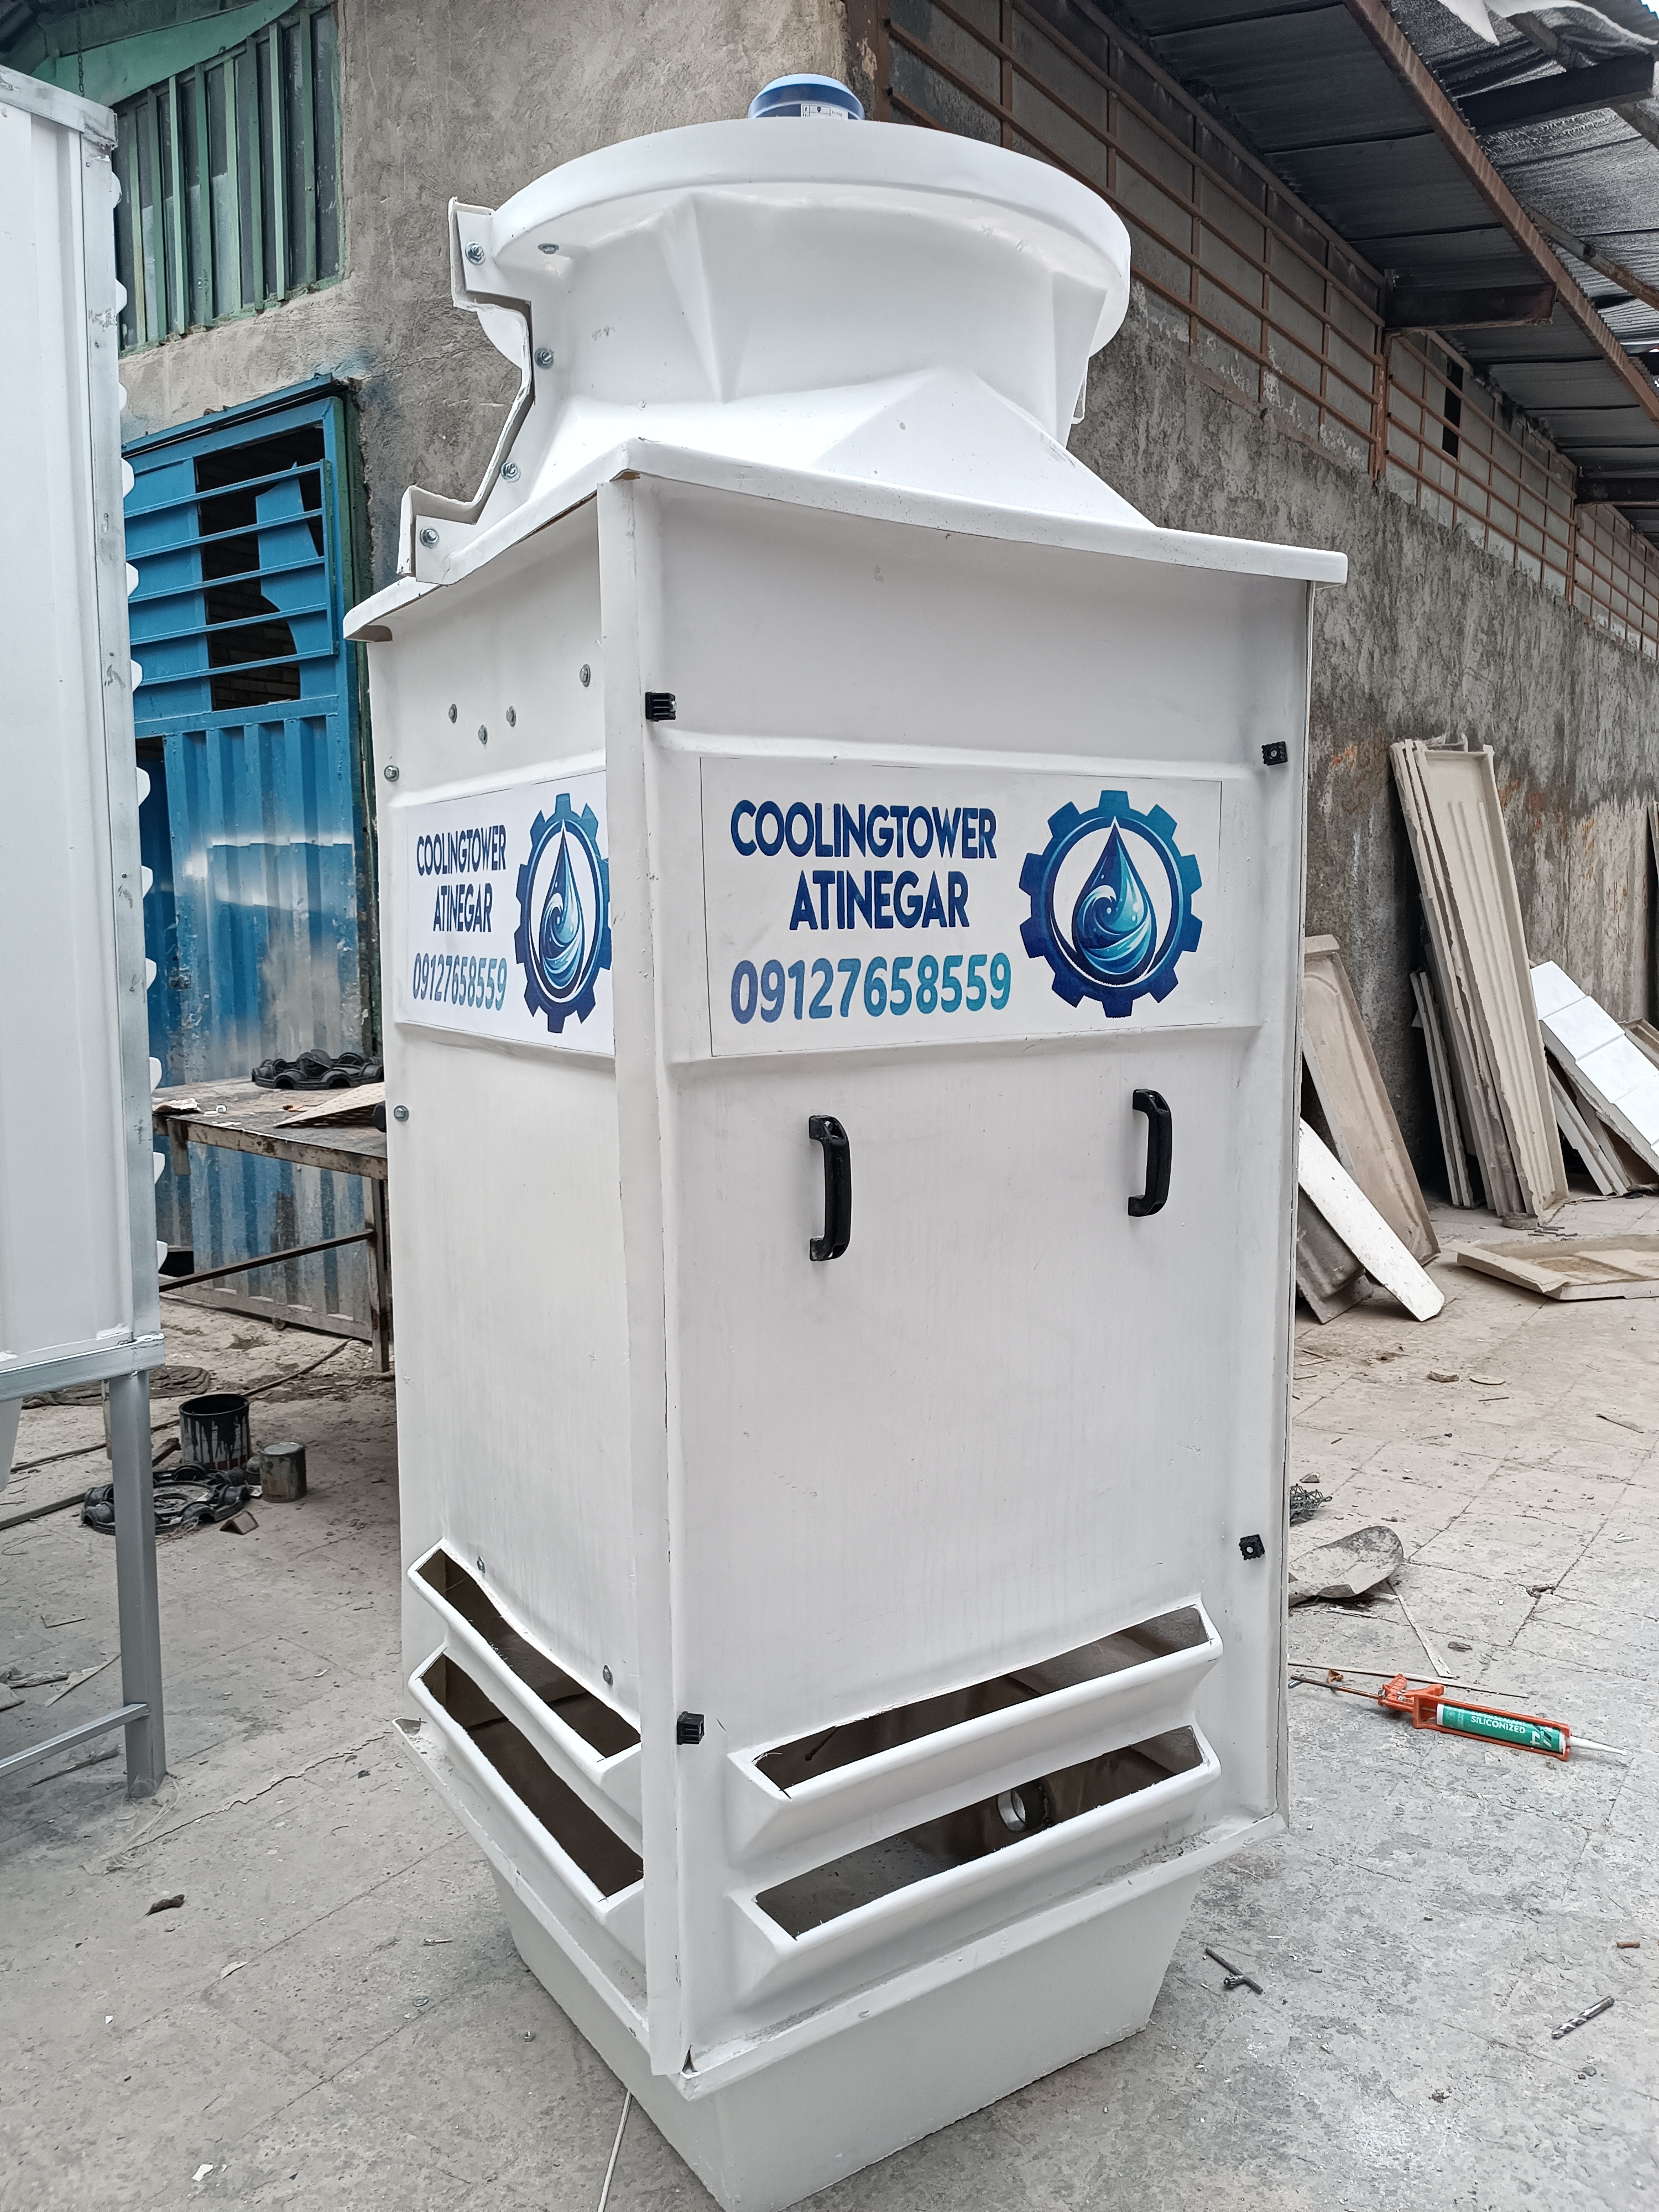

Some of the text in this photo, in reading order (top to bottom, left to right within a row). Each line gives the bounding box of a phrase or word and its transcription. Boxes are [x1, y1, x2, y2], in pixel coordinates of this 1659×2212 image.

[416, 825, 507, 876] COOLINGTOWER
[731, 800, 997, 859] COOLINGTOWER
[433, 883, 493, 932] ATINEGAR
[789, 870, 970, 931] ATINEGAR
[413, 953, 507, 1011] 09127658559
[731, 952, 1011, 1024] 09127658559
[1470, 1715, 1526, 1734] SILICONIZED
